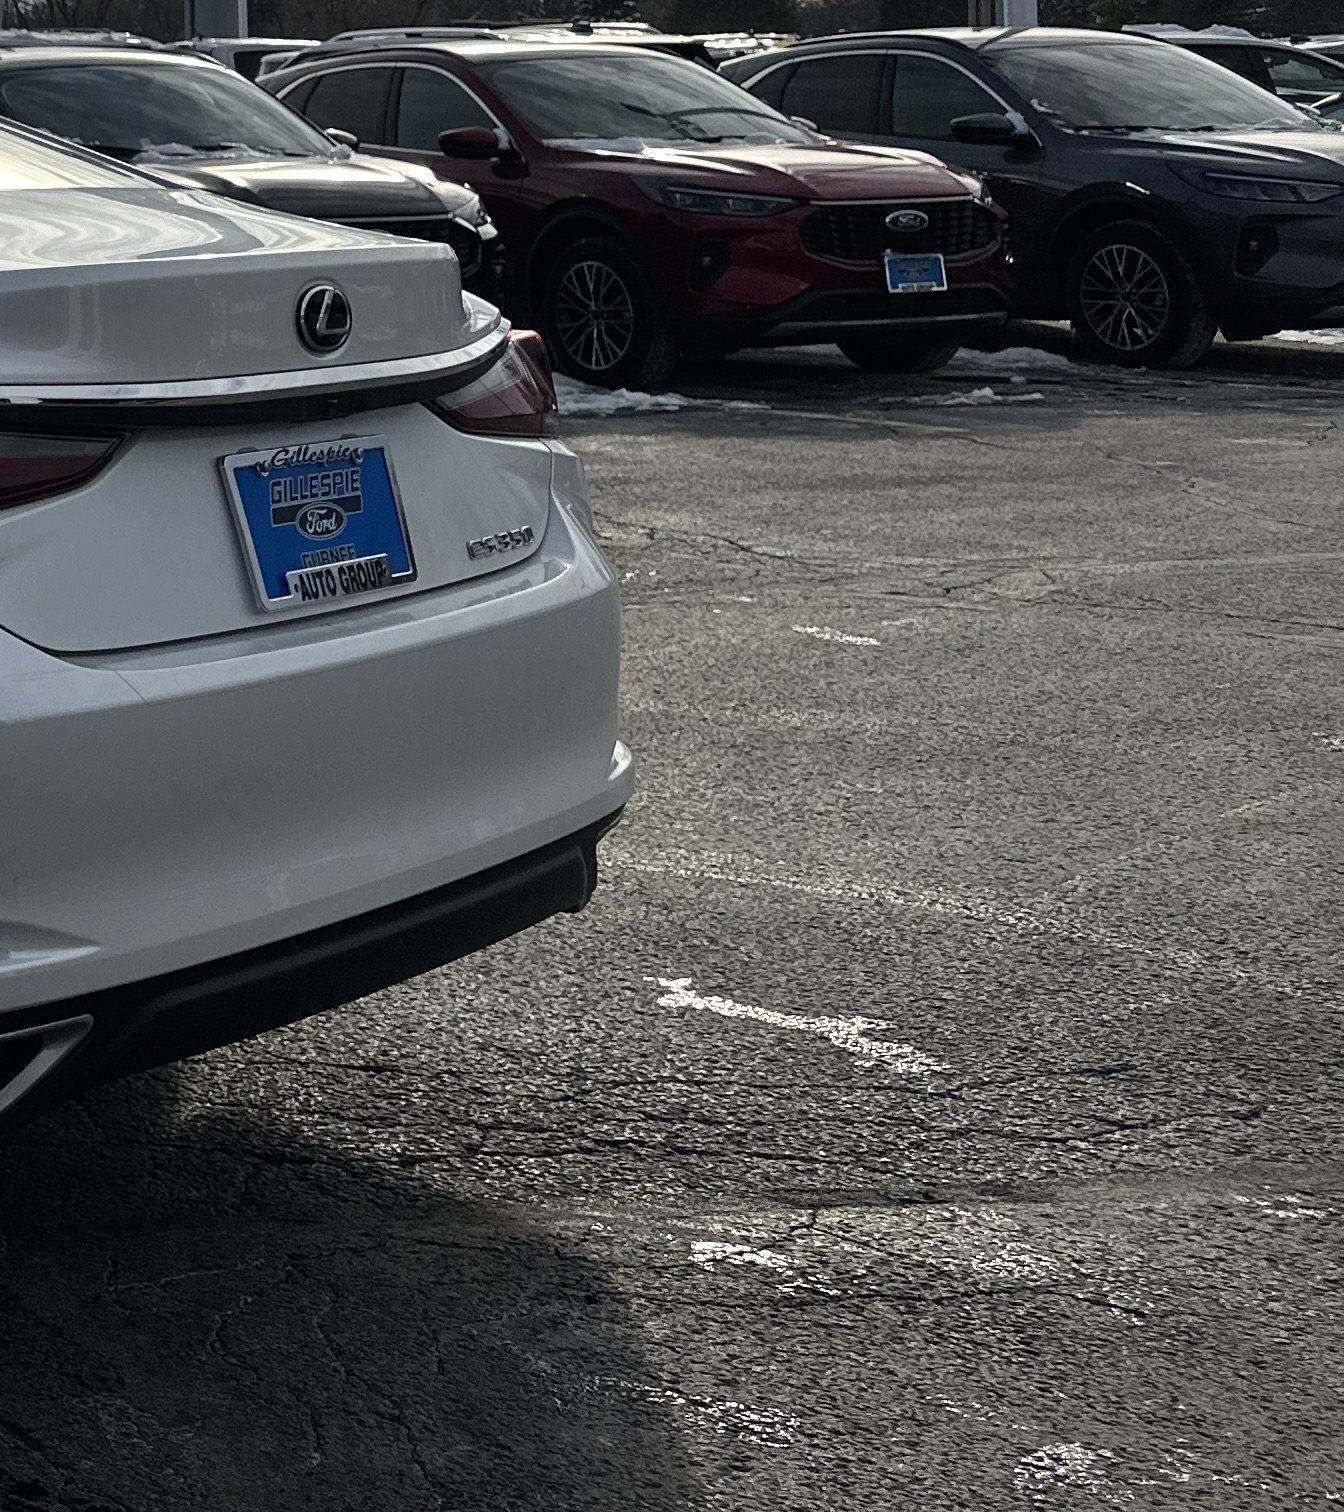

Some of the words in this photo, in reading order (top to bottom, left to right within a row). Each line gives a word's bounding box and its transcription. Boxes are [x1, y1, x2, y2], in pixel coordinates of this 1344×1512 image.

[270, 445, 353, 469] Gillespie
[269, 467, 362, 506] GILLESPIE
[306, 508, 338, 534] Ford
[494, 525, 535, 553] 350
[297, 568, 337, 602] AUTO
[337, 560, 384, 595] GROUP
